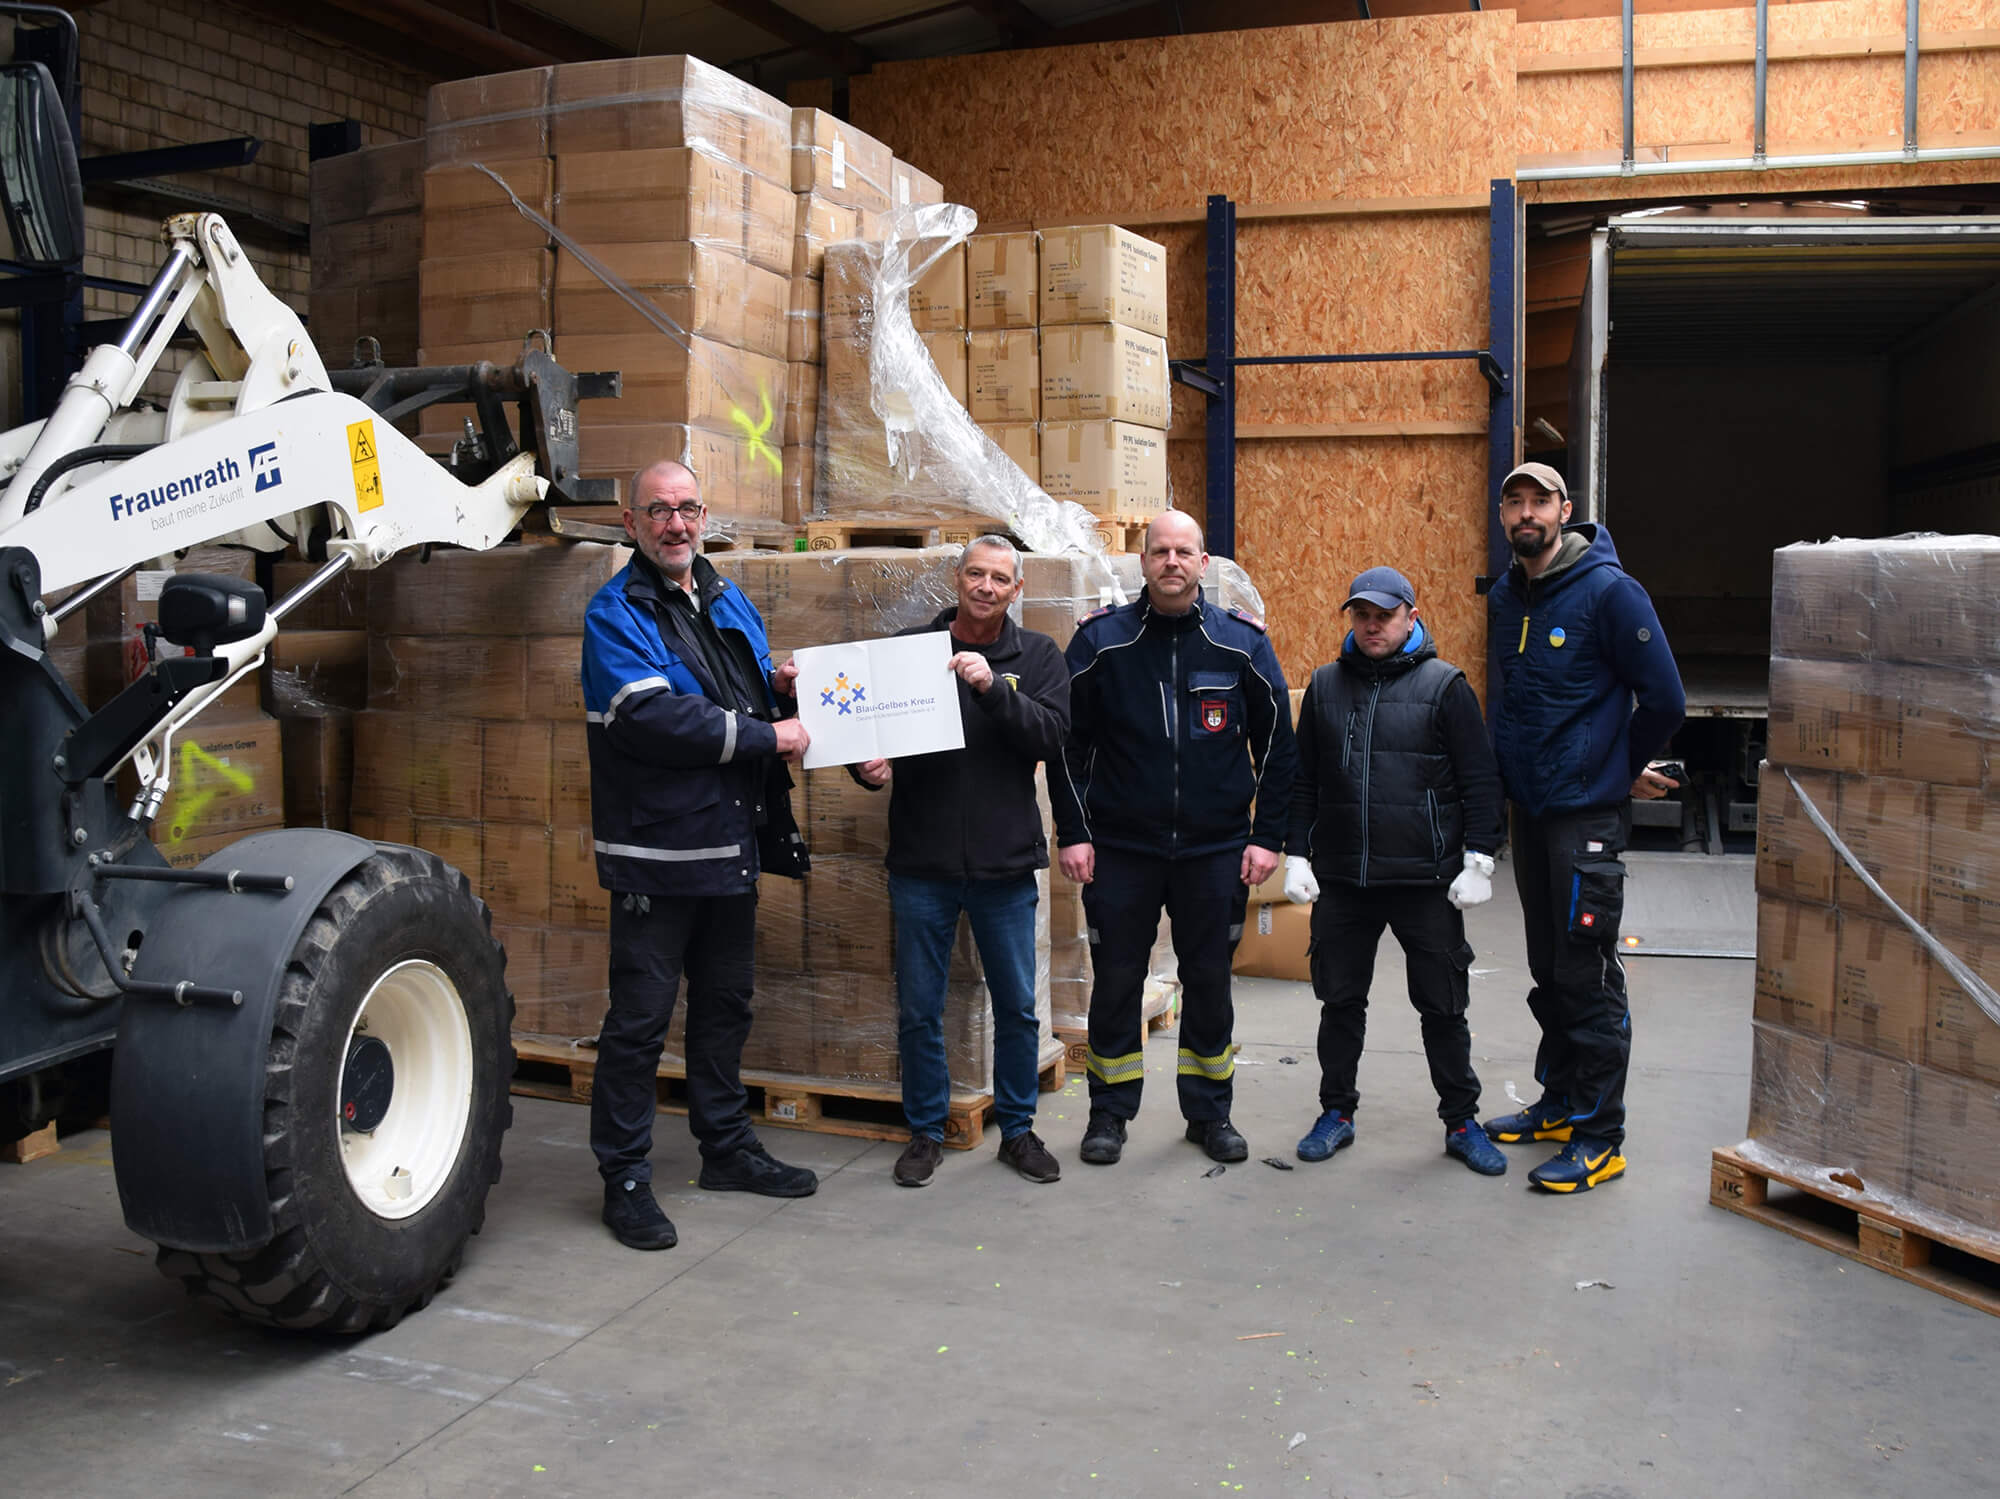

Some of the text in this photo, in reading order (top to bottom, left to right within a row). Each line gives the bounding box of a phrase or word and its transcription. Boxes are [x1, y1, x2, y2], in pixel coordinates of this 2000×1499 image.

[109, 457, 240, 521] Frauenrath
[151, 486, 245, 531] baut meine Zukunft
[814, 539, 832, 550] EPAL
[855, 696, 936, 714] Blau-Gelbes Kreuz
[234, 739, 257, 749] Gown
